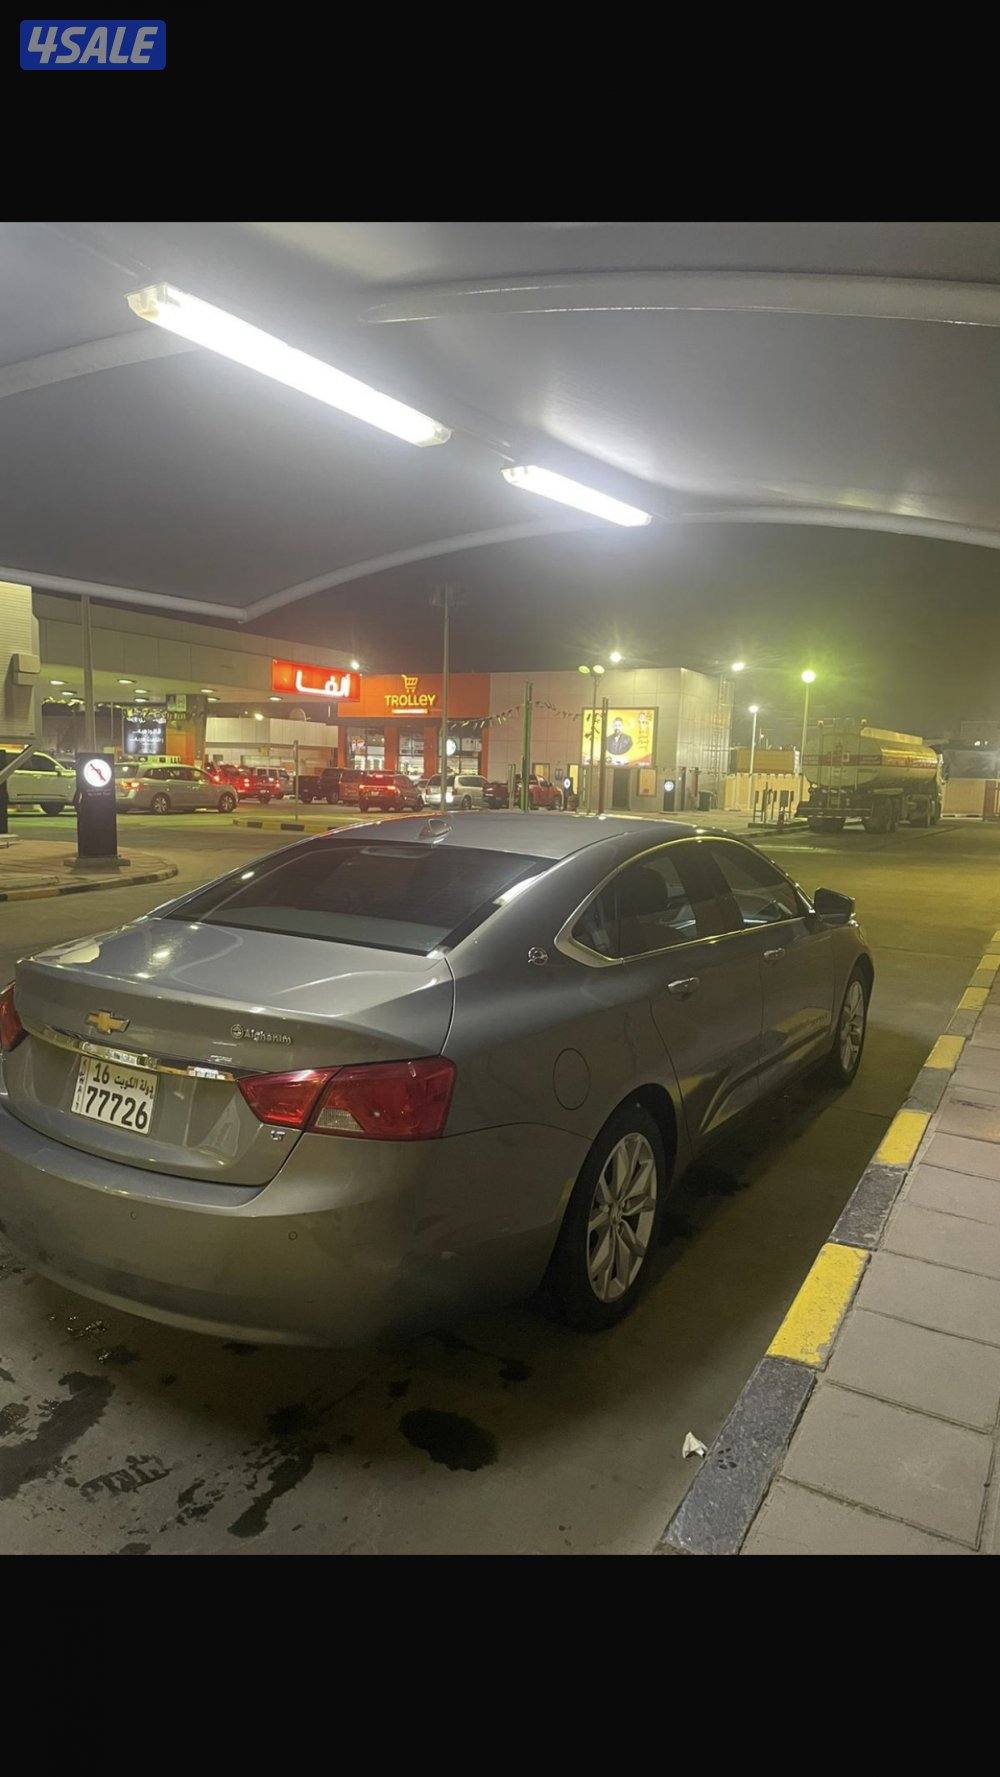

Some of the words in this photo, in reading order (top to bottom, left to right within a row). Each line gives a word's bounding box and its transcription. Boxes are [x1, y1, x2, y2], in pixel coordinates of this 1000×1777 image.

[92, 1062, 110, 1085] 16
[114, 1075, 139, 1091] الكويت
[139, 1079, 154, 1100] دولة
[85, 1085, 148, 1130] 77726
